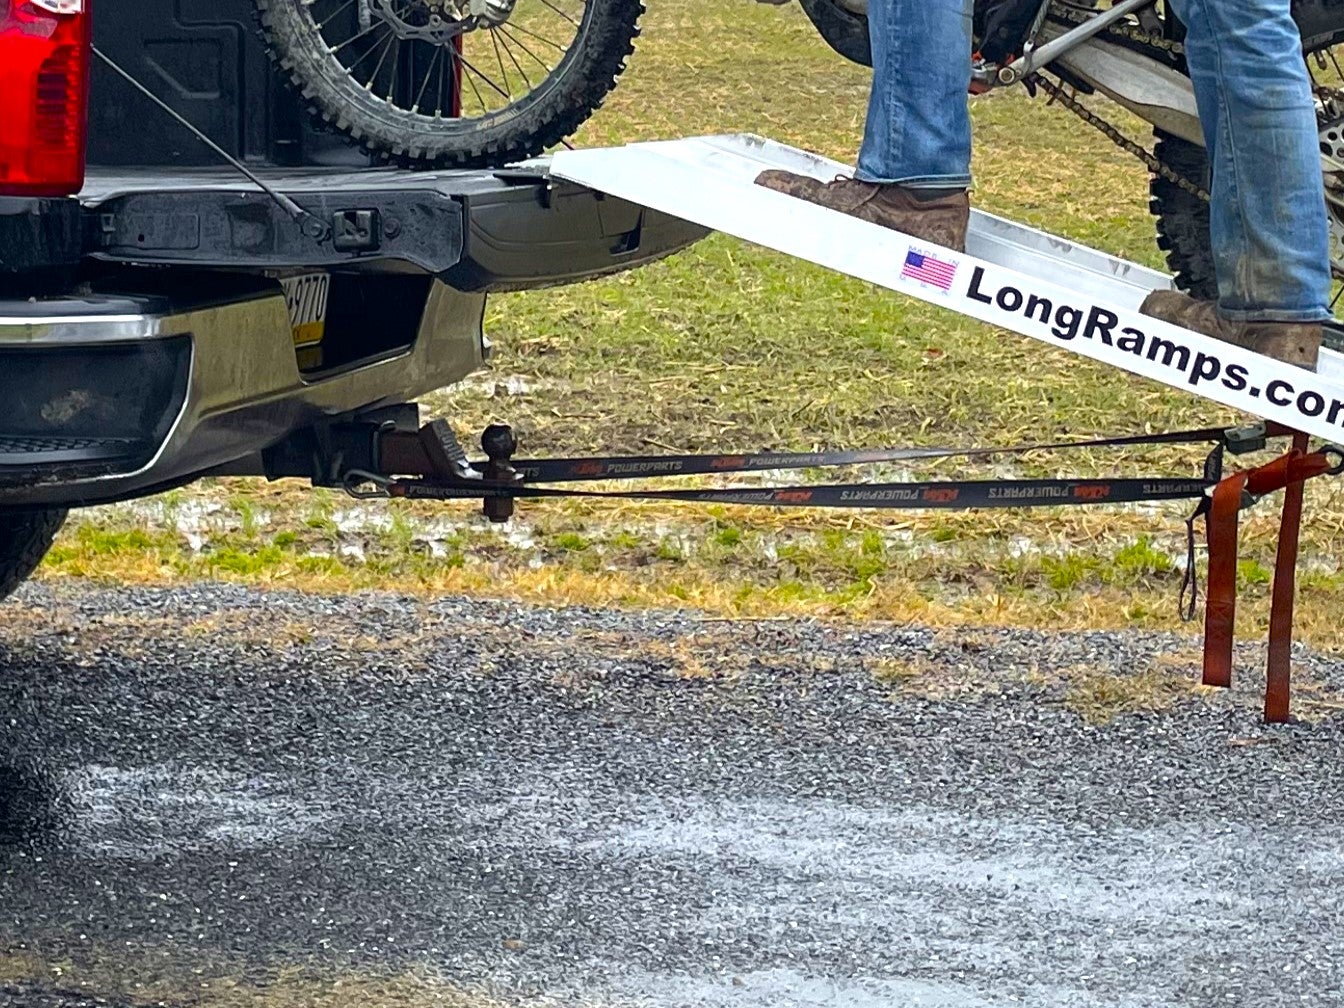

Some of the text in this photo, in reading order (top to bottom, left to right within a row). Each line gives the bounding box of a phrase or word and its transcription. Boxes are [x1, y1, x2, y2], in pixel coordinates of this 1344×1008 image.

[607, 460, 683, 473] POWERPARTS
[839, 488, 919, 502] POWERPARTS
[988, 484, 1069, 500] POWERPARTS
